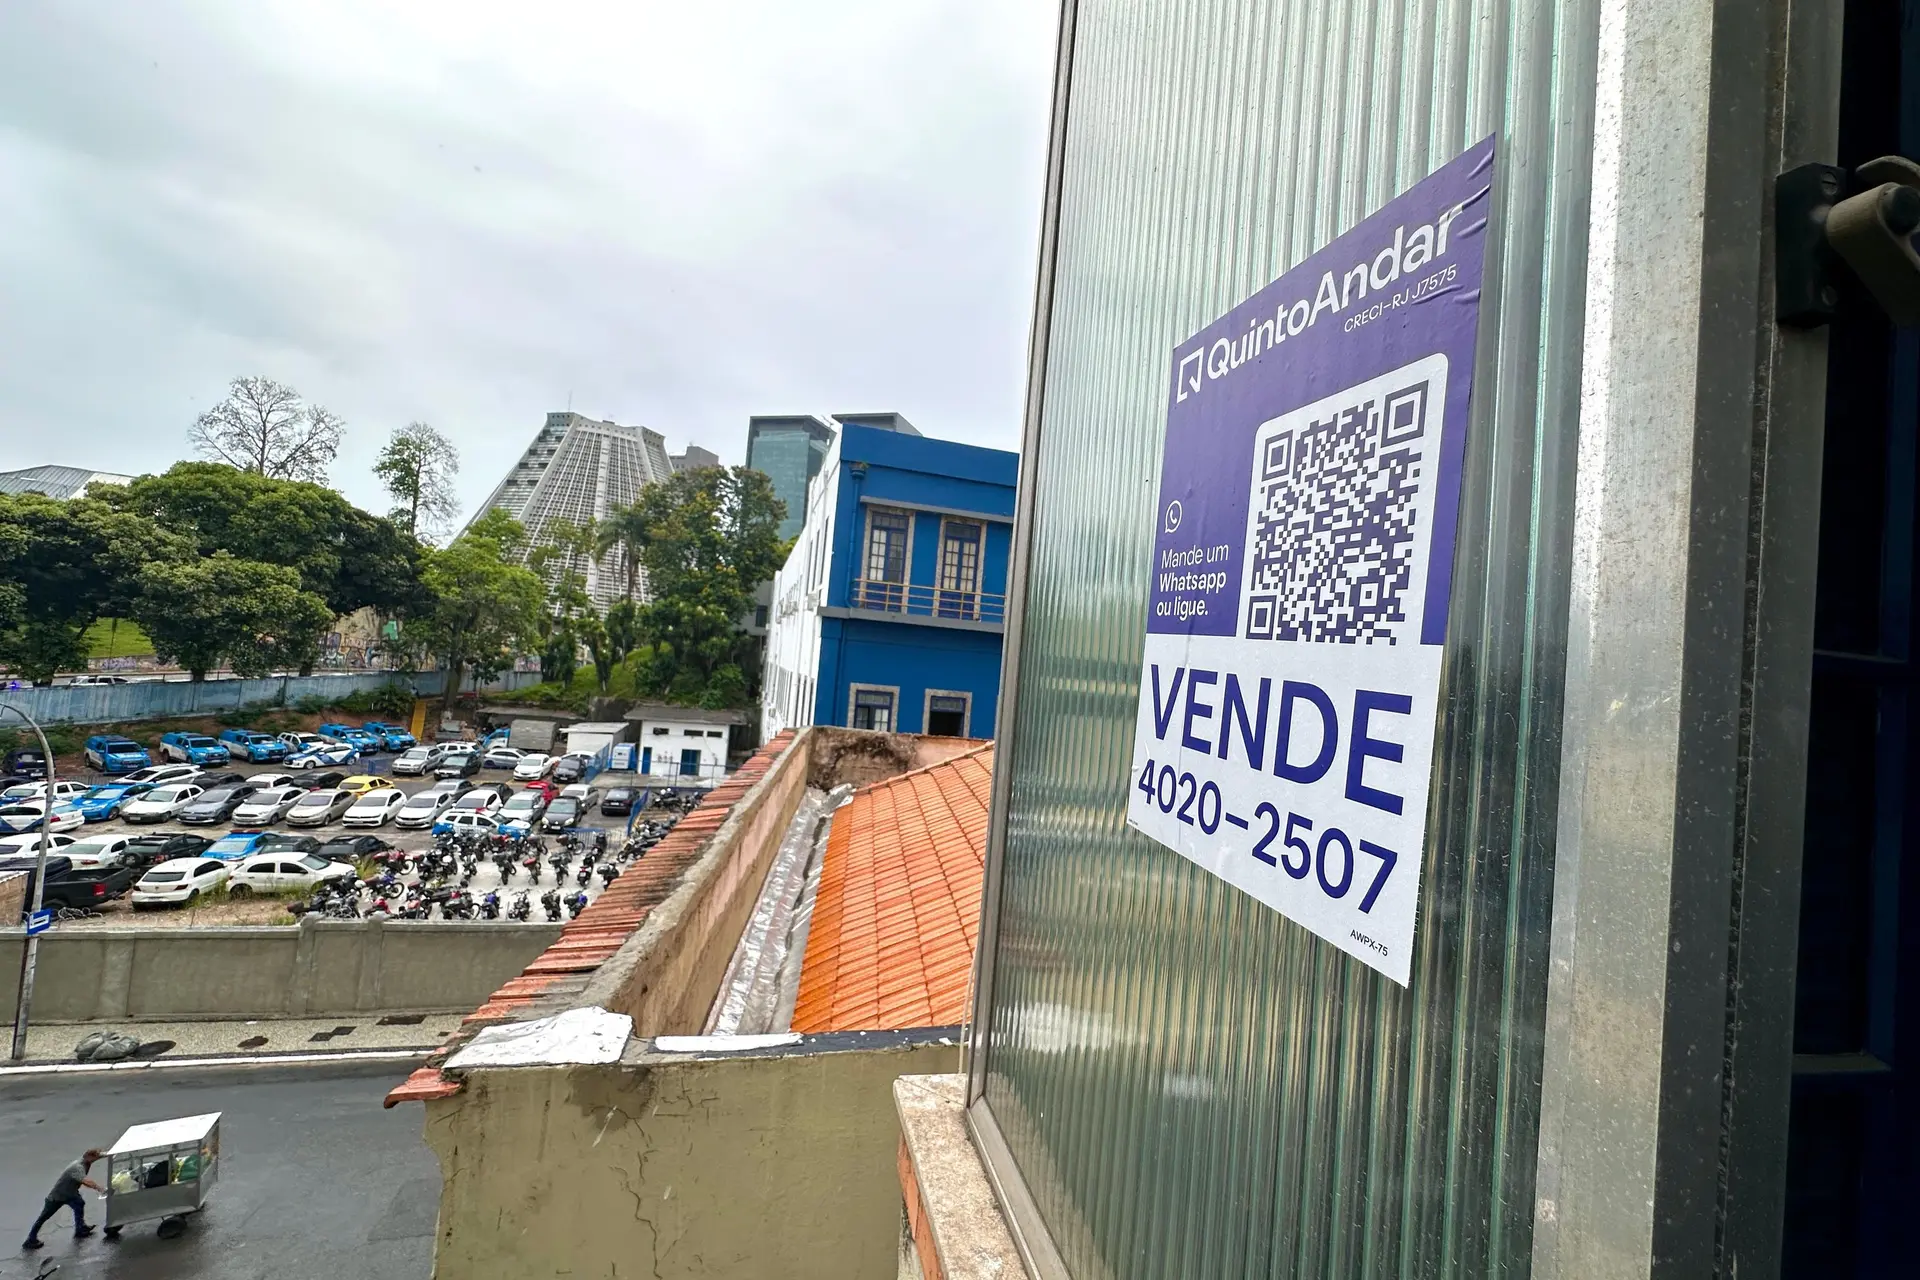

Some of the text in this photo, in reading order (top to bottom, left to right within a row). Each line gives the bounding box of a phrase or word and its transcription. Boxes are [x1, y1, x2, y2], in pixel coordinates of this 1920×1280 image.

[1206, 204, 1464, 380] QuintoAndar
[1344, 288, 1410, 332] CRECI-RJ
[1161, 544, 1229, 569] Mande um
[1160, 571, 1227, 594] Whatsapp
[1156, 596, 1209, 621] ou ligue.
[1150, 664, 1413, 816] VENDE
[1138, 758, 1398, 915] 4020-2507
[1350, 929, 1388, 957] AWPX-75
